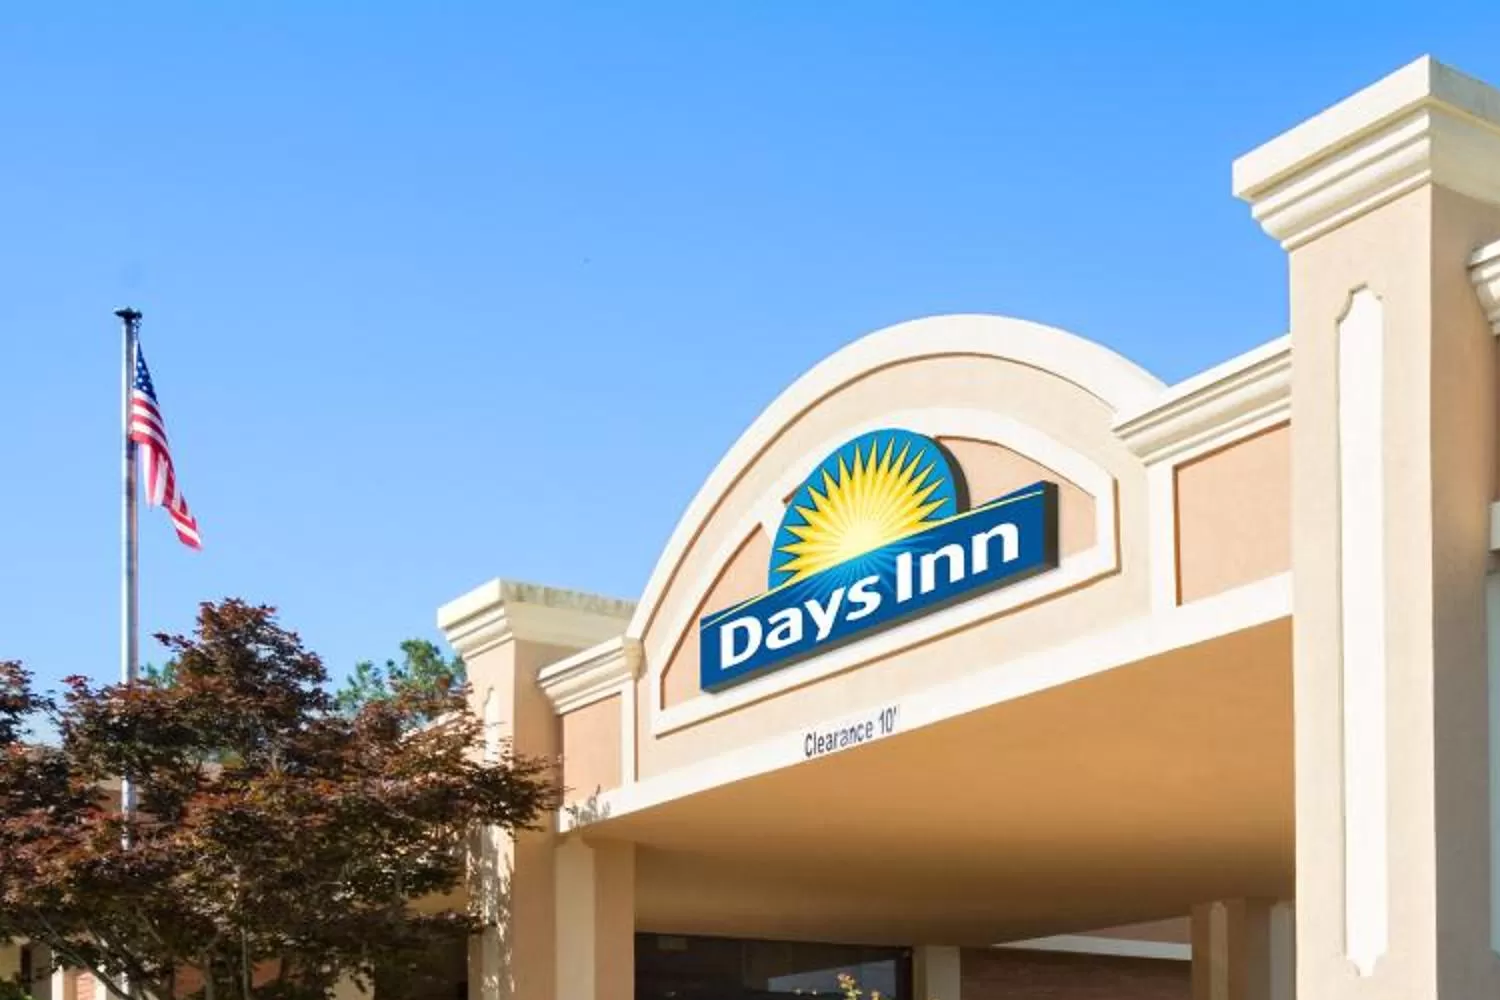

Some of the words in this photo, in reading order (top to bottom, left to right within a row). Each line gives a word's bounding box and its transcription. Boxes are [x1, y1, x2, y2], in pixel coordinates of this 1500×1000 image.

[720, 575, 881, 670] Days
[896, 521, 1019, 603] Inn
[804, 720, 873, 757] Clearance
